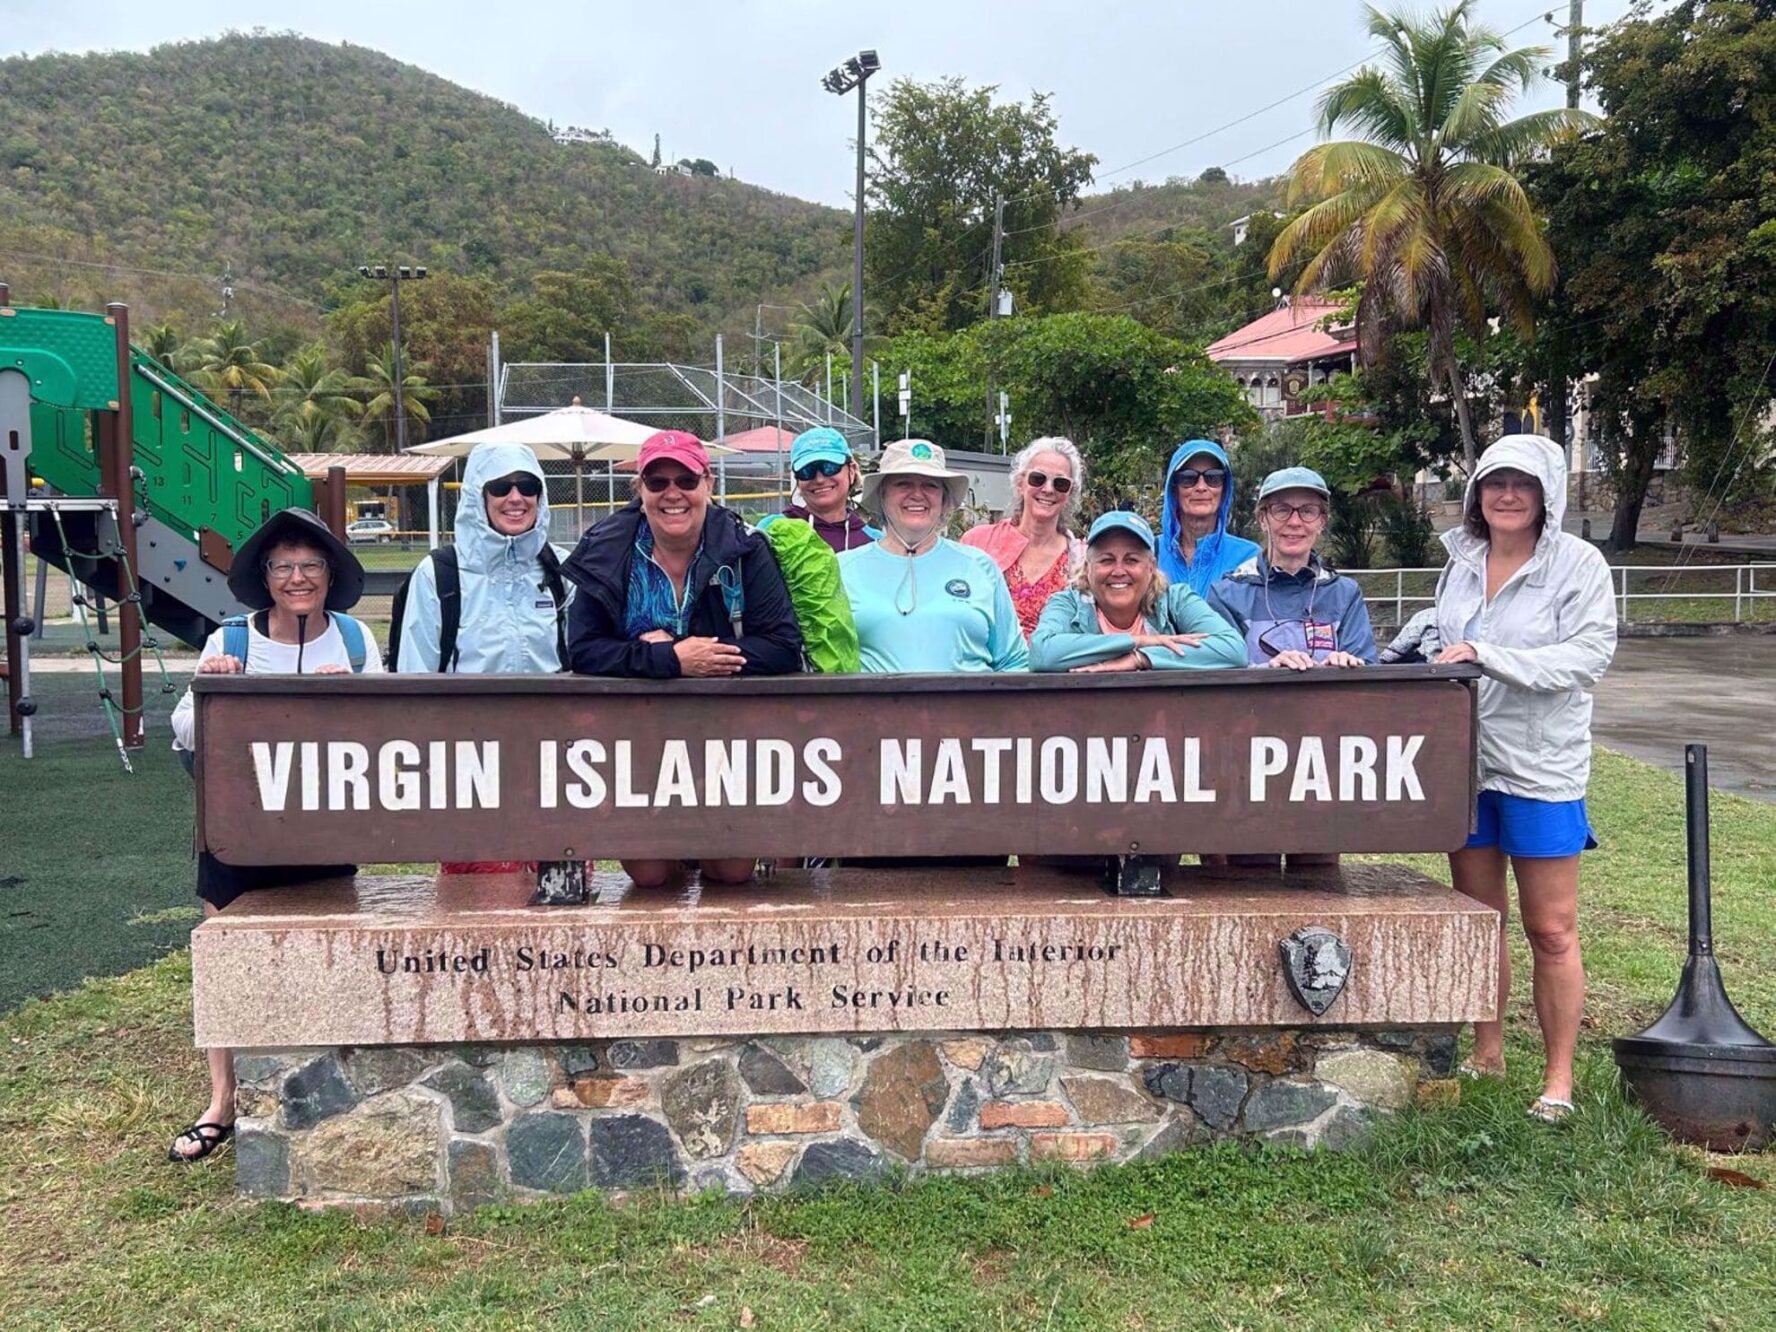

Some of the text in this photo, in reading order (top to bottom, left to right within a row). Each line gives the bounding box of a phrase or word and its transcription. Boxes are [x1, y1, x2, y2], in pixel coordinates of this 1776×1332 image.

[251, 735, 1426, 812] VIRGIN ISLANDS NATIONAL PARK
[377, 938, 1121, 974] United States Department of the Interior
[559, 984, 949, 1014] National Park Service
